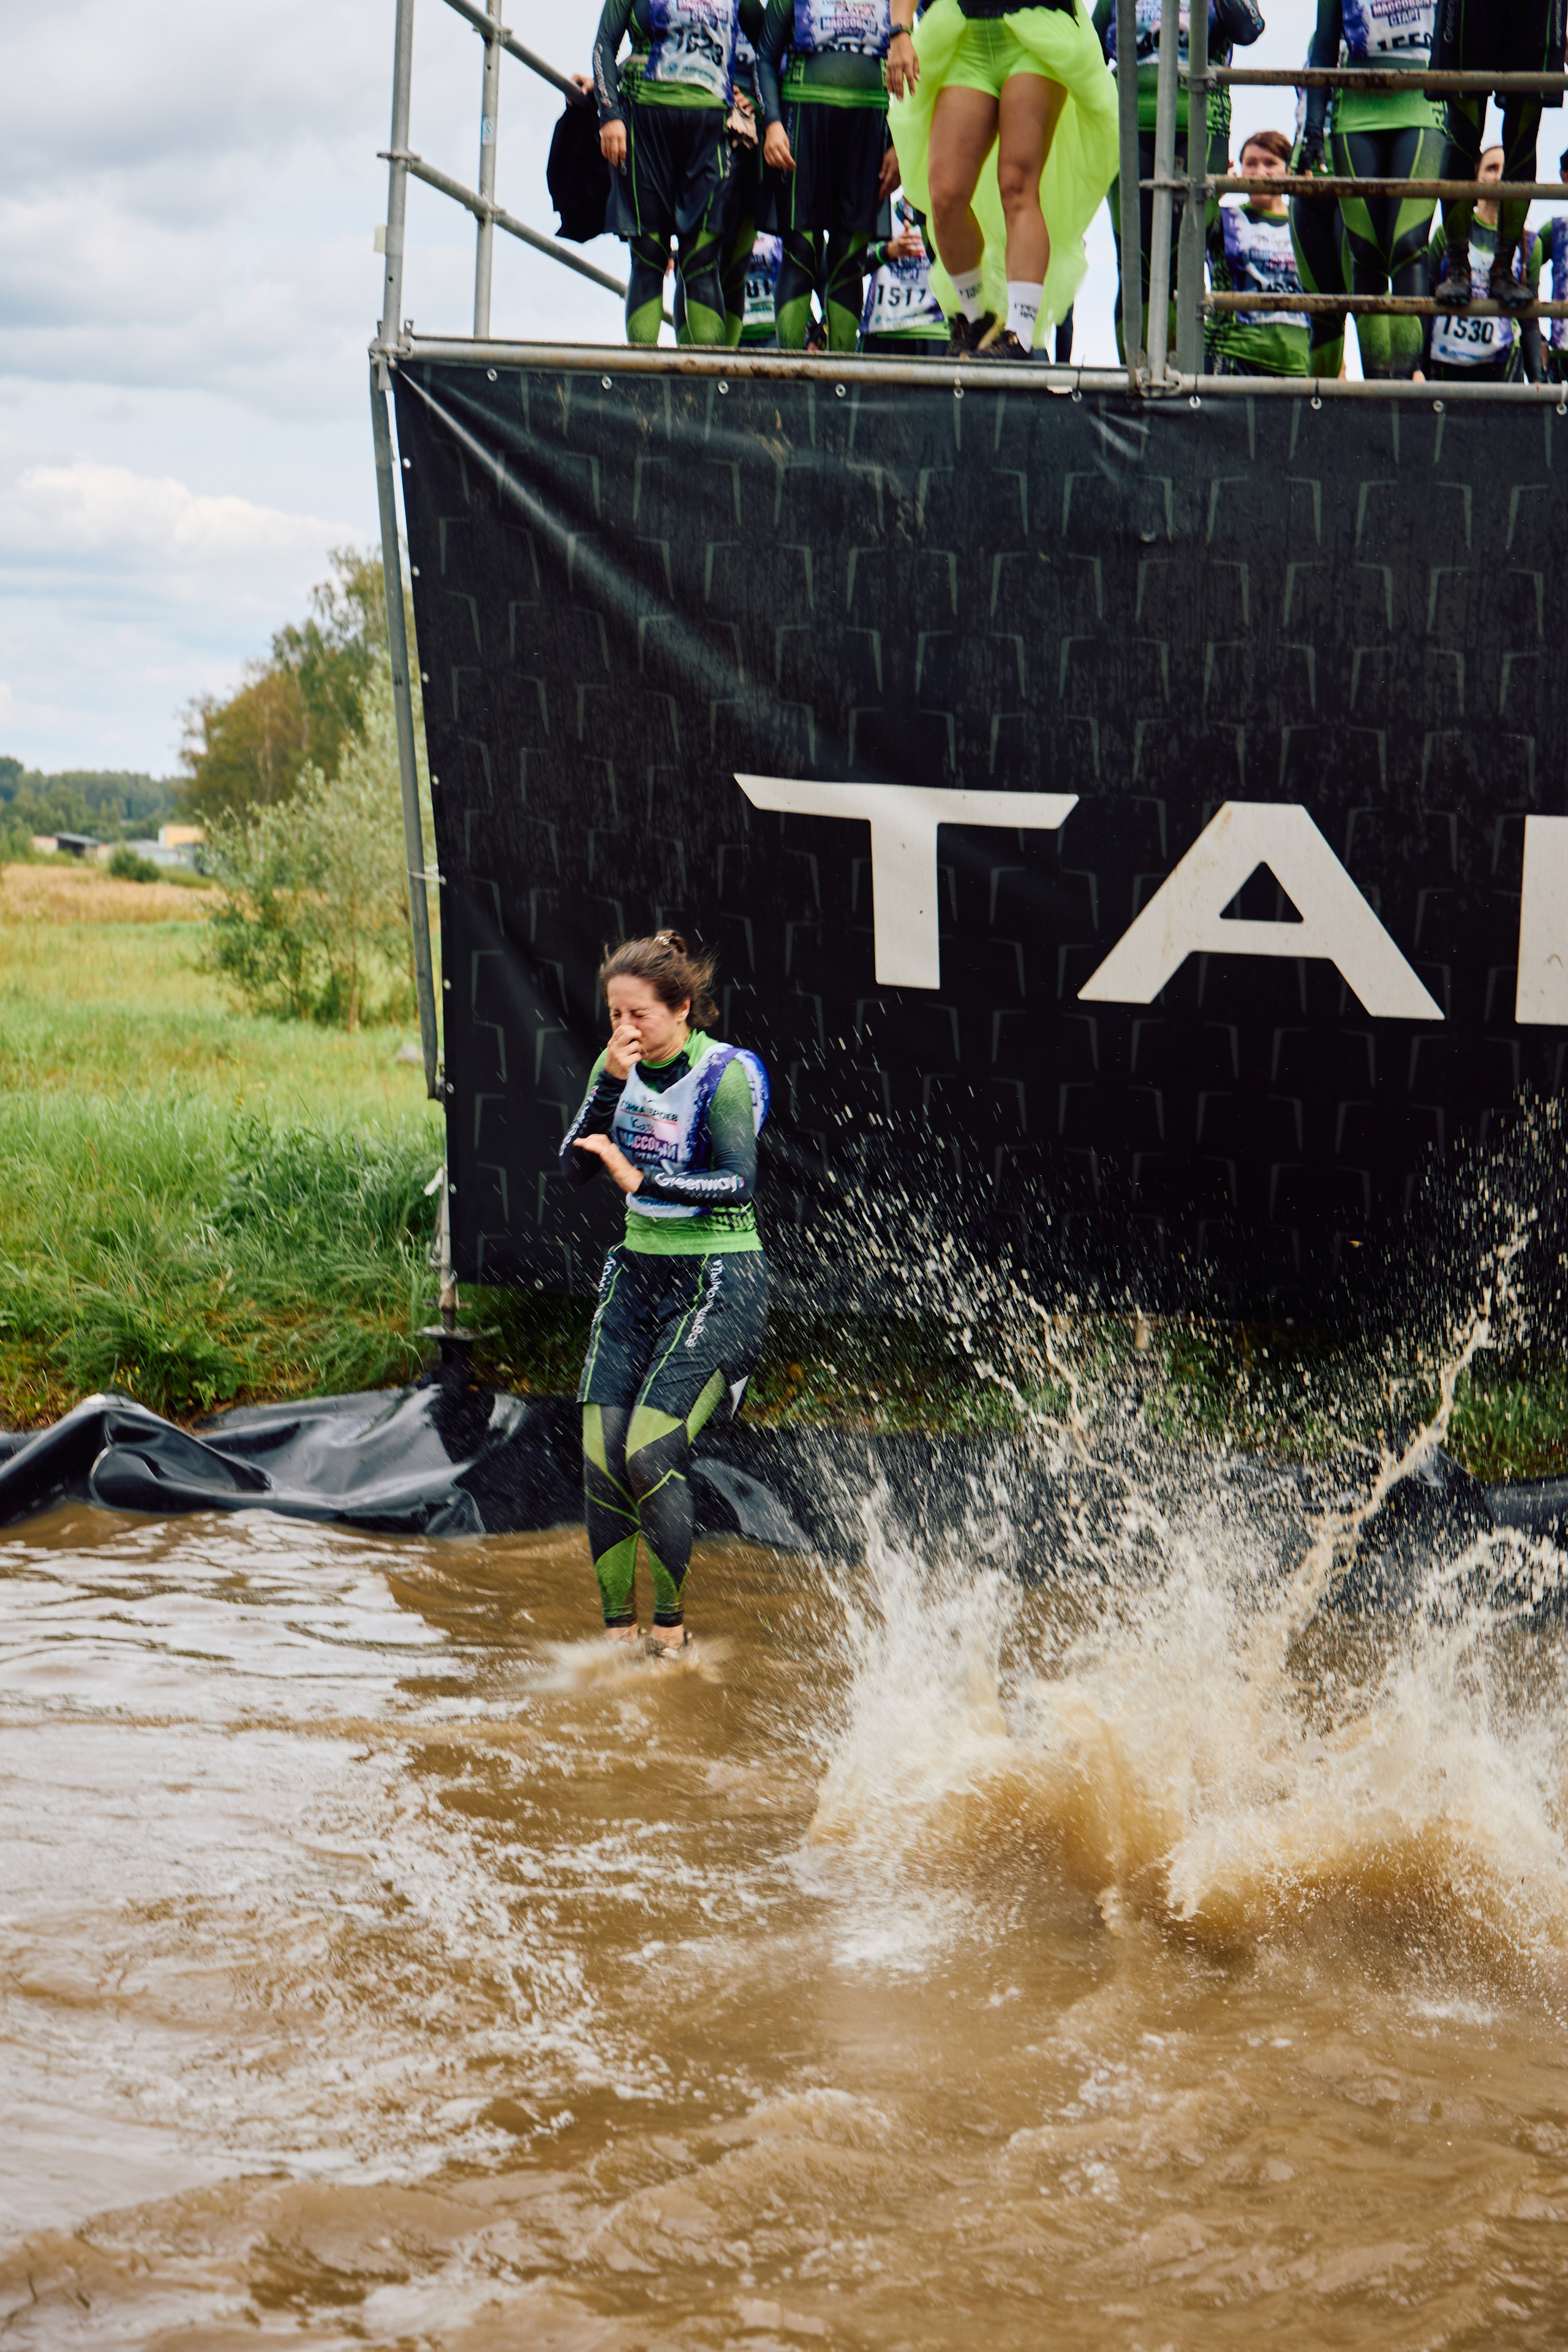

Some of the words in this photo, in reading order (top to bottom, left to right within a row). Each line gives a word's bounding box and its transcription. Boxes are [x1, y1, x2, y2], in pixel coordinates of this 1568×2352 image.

[878, 284, 926, 306] 1517
[1442, 314, 1494, 344] 1530
[654, 1172, 738, 1193] Greenway
